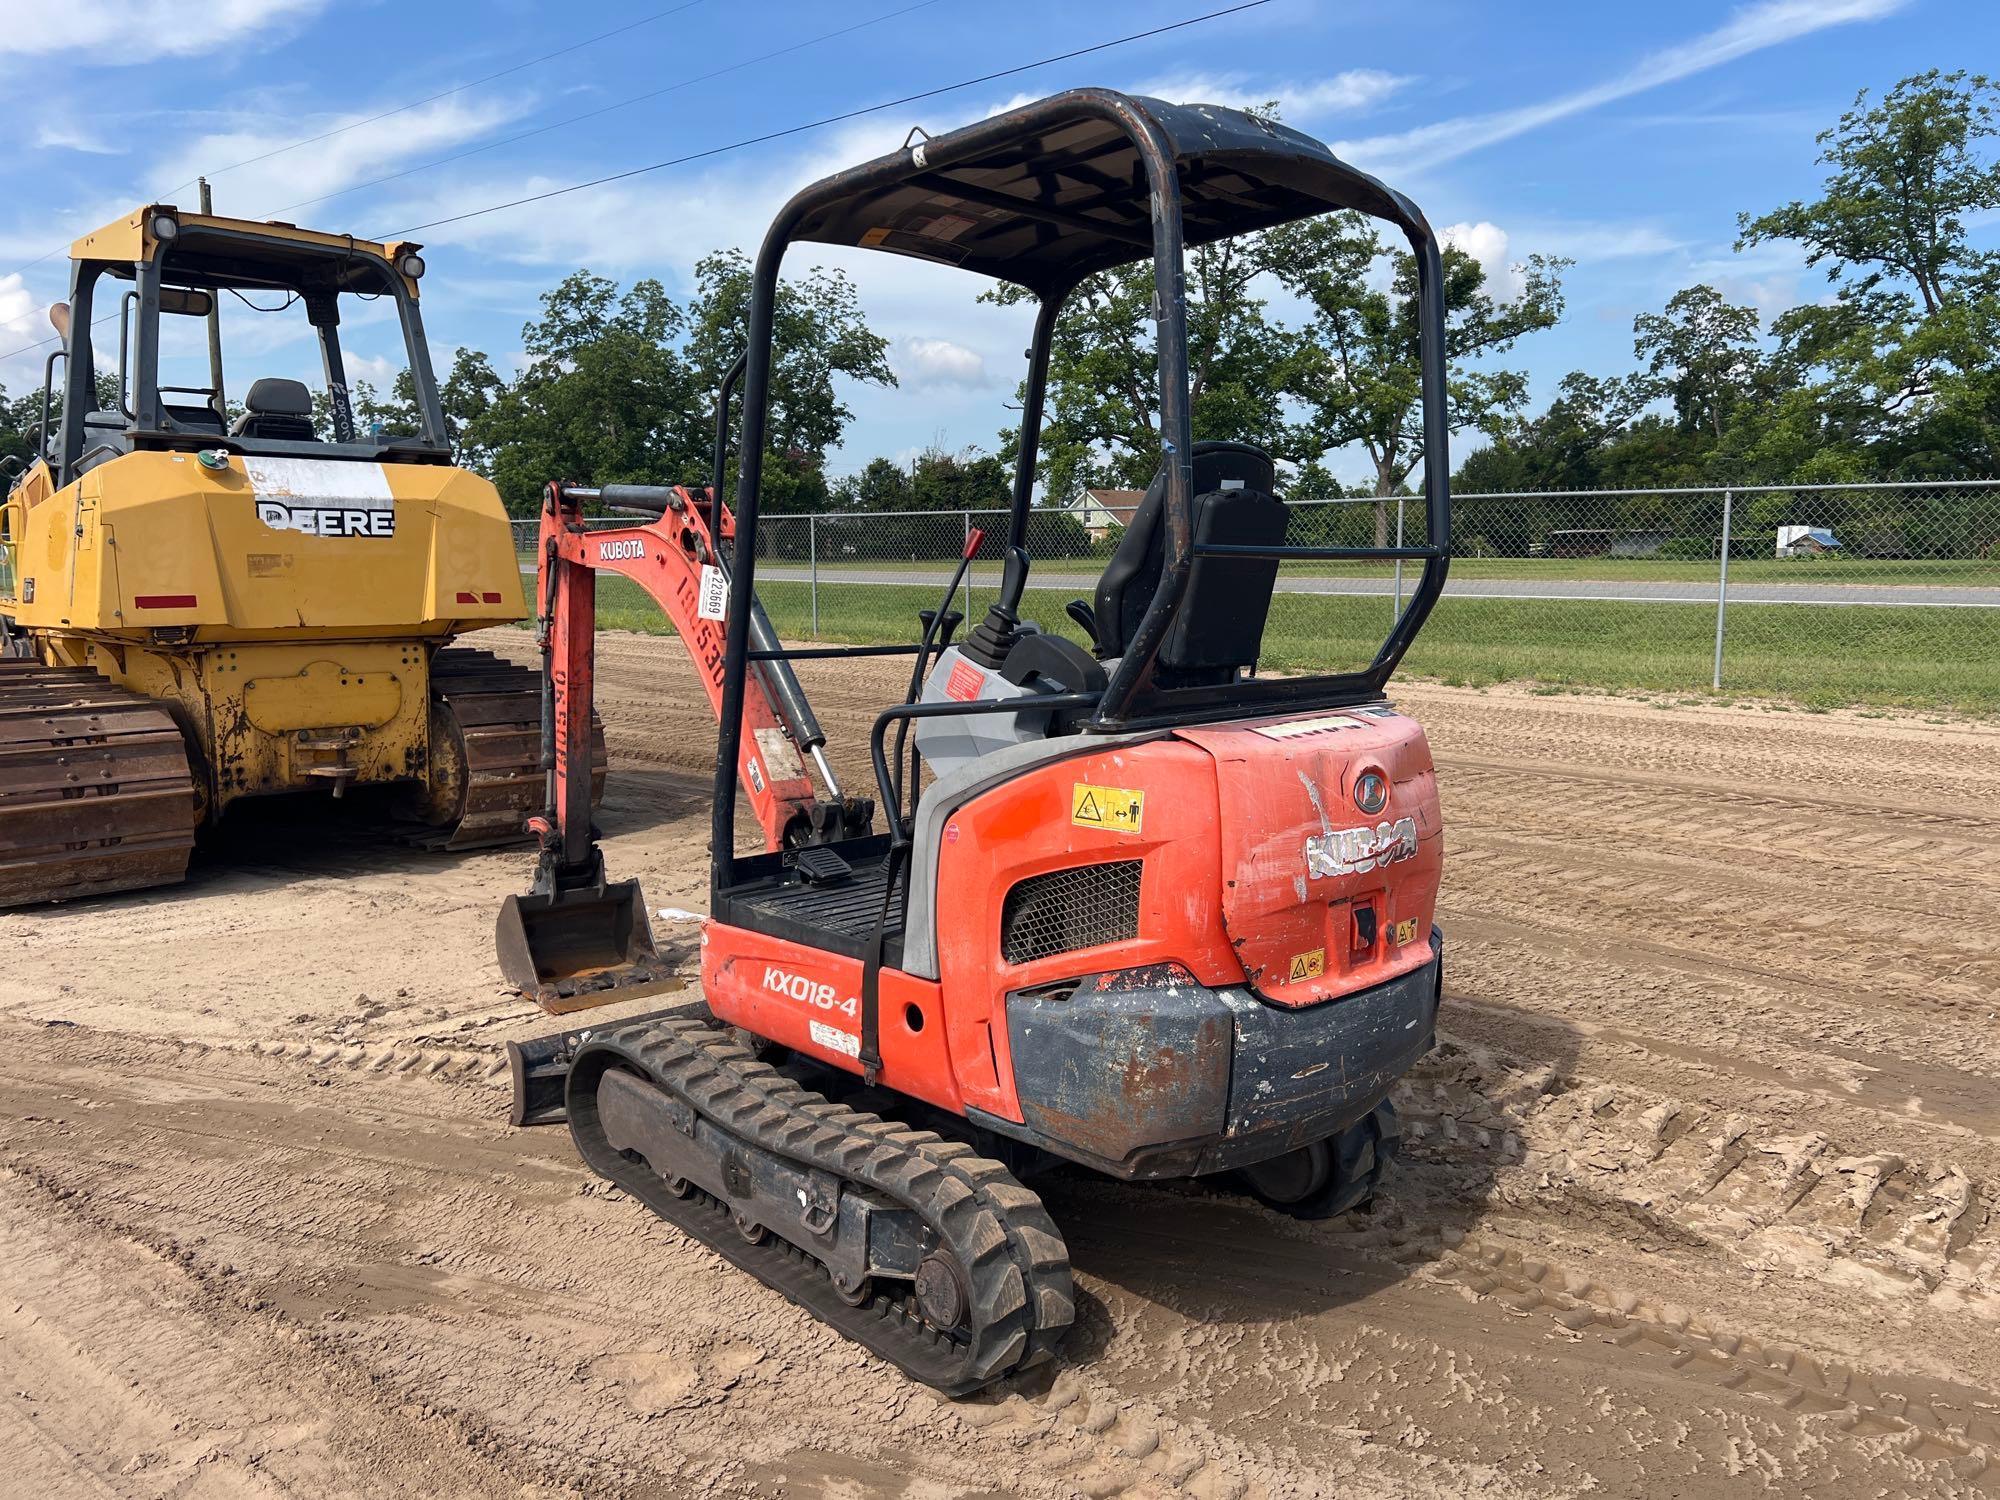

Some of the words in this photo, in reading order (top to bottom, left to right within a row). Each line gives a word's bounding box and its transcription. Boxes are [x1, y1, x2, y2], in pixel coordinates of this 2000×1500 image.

[258, 502, 394, 537] DEERE
[600, 539, 645, 560] KUBOTA
[709, 577, 724, 614] 223669
[763, 966, 857, 1017] KX018-4
